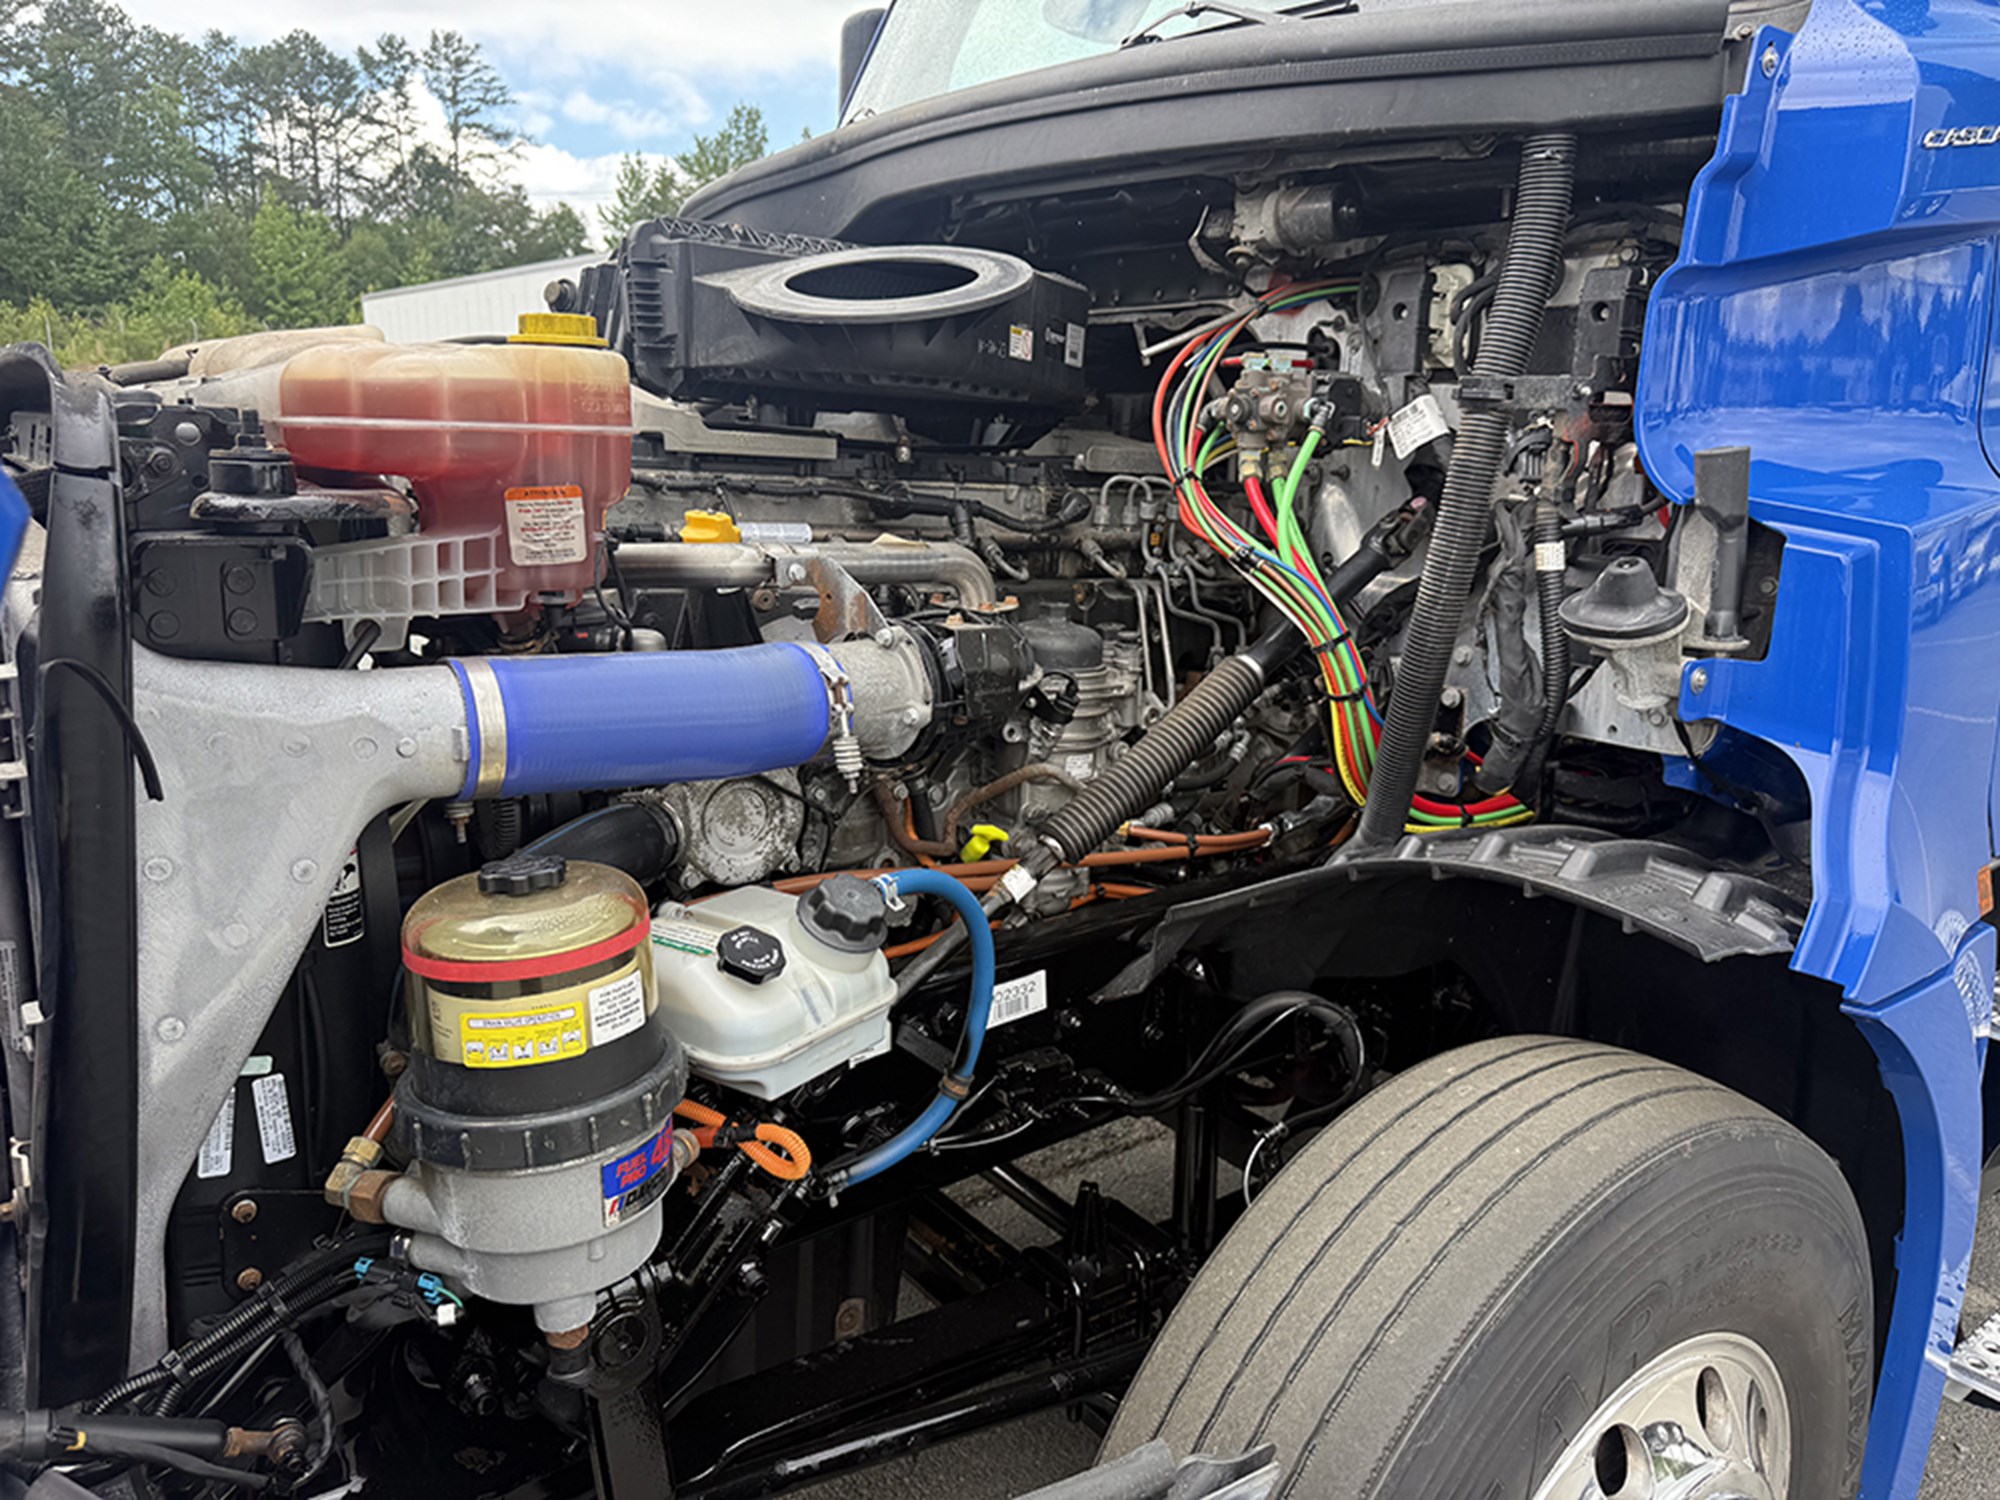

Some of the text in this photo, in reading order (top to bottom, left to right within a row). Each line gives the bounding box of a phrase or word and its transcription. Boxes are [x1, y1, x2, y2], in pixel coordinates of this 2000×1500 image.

[1923, 126, 2000, 148] CASC
[616, 1152, 647, 1178] FUEL
[620, 1164, 647, 1189] PRO
